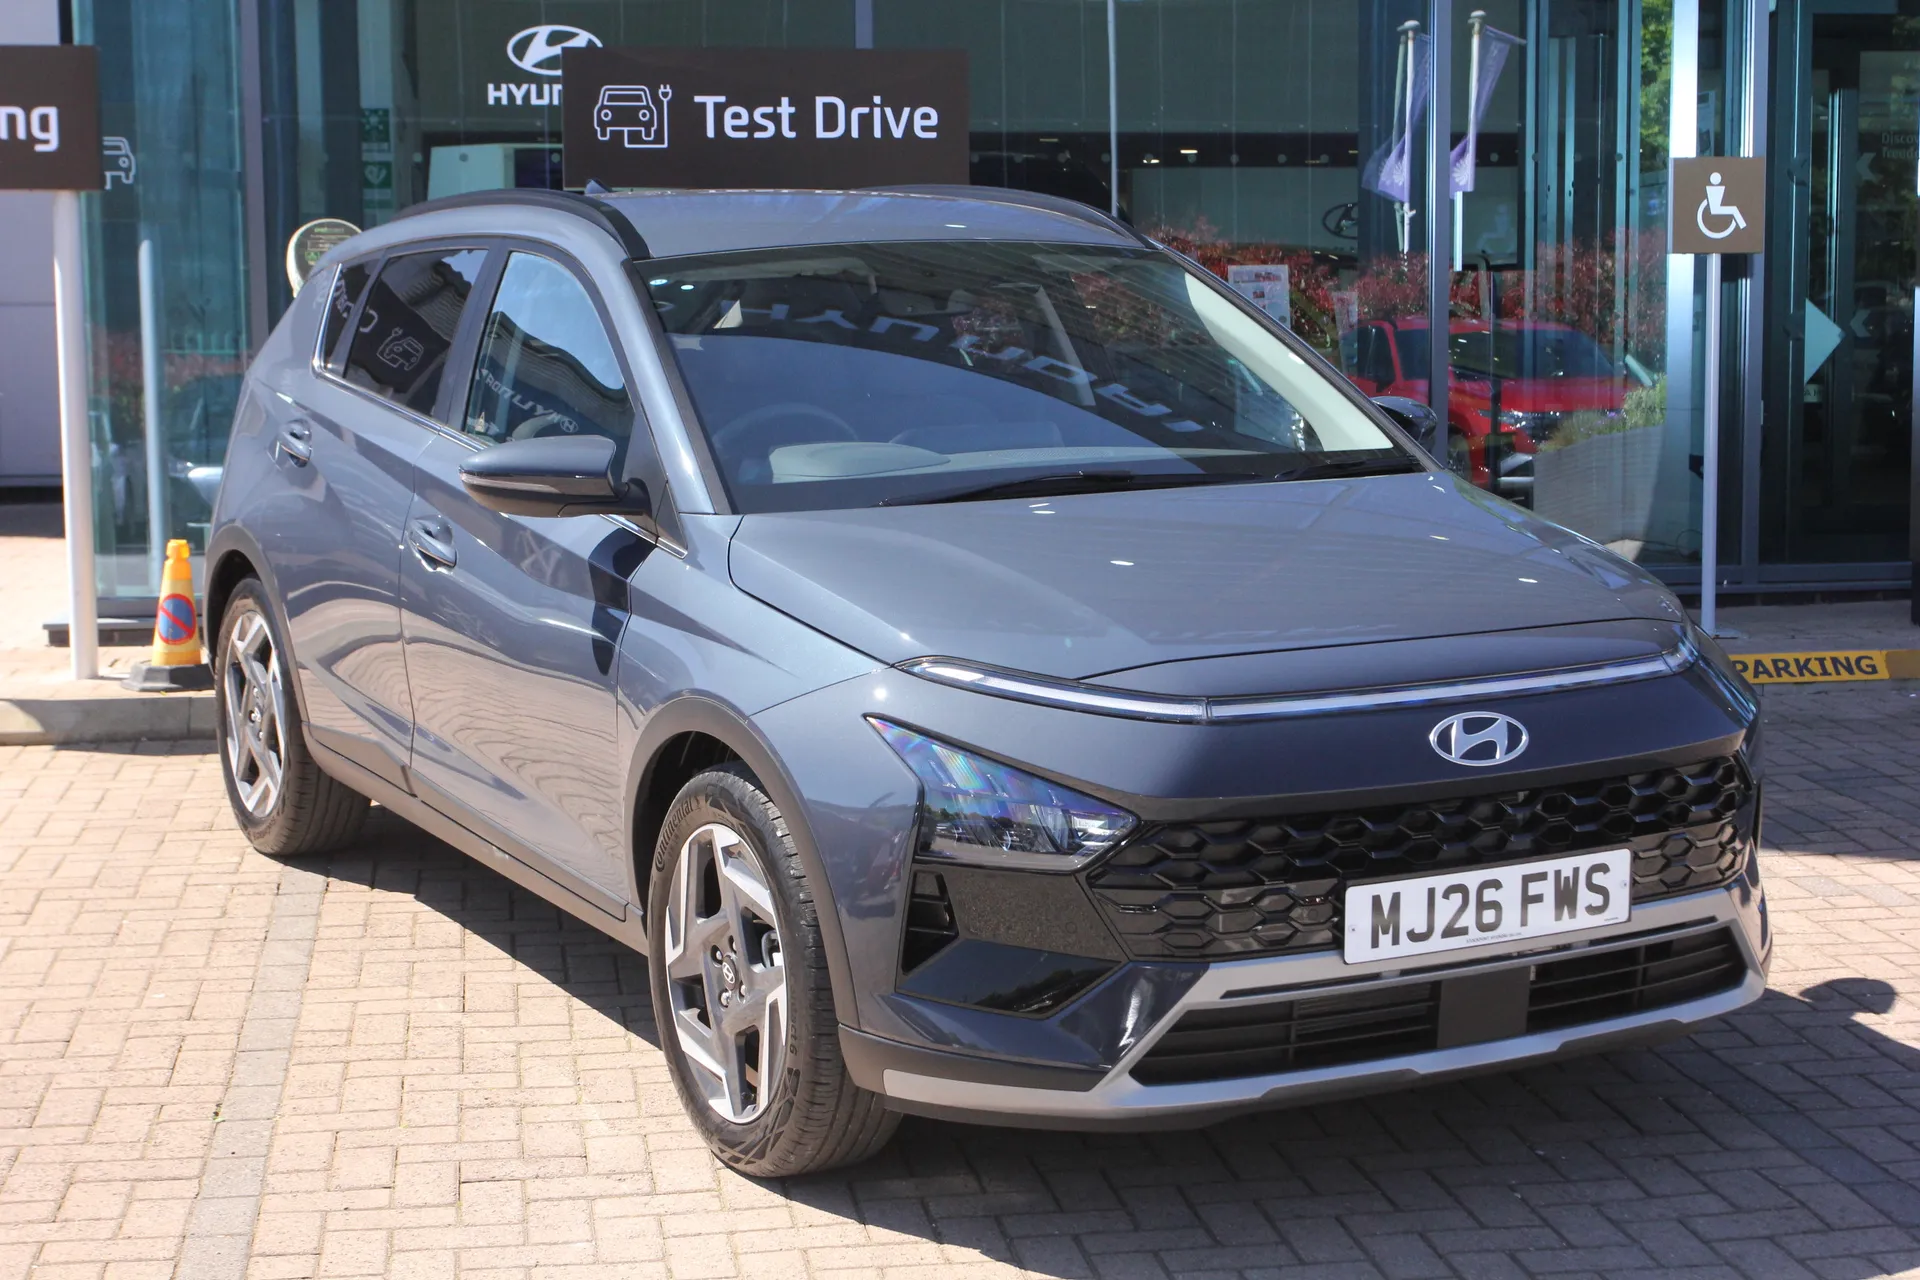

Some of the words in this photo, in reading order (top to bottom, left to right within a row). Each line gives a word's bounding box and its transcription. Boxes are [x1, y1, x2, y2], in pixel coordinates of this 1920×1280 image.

[693, 95, 797, 139] Test
[815, 95, 939, 139] Drive
[1731, 655, 1879, 680] PARKING
[655, 795, 695, 873] Continental
[1370, 878, 1504, 950] MJ26
[1519, 862, 1611, 928] FWS
